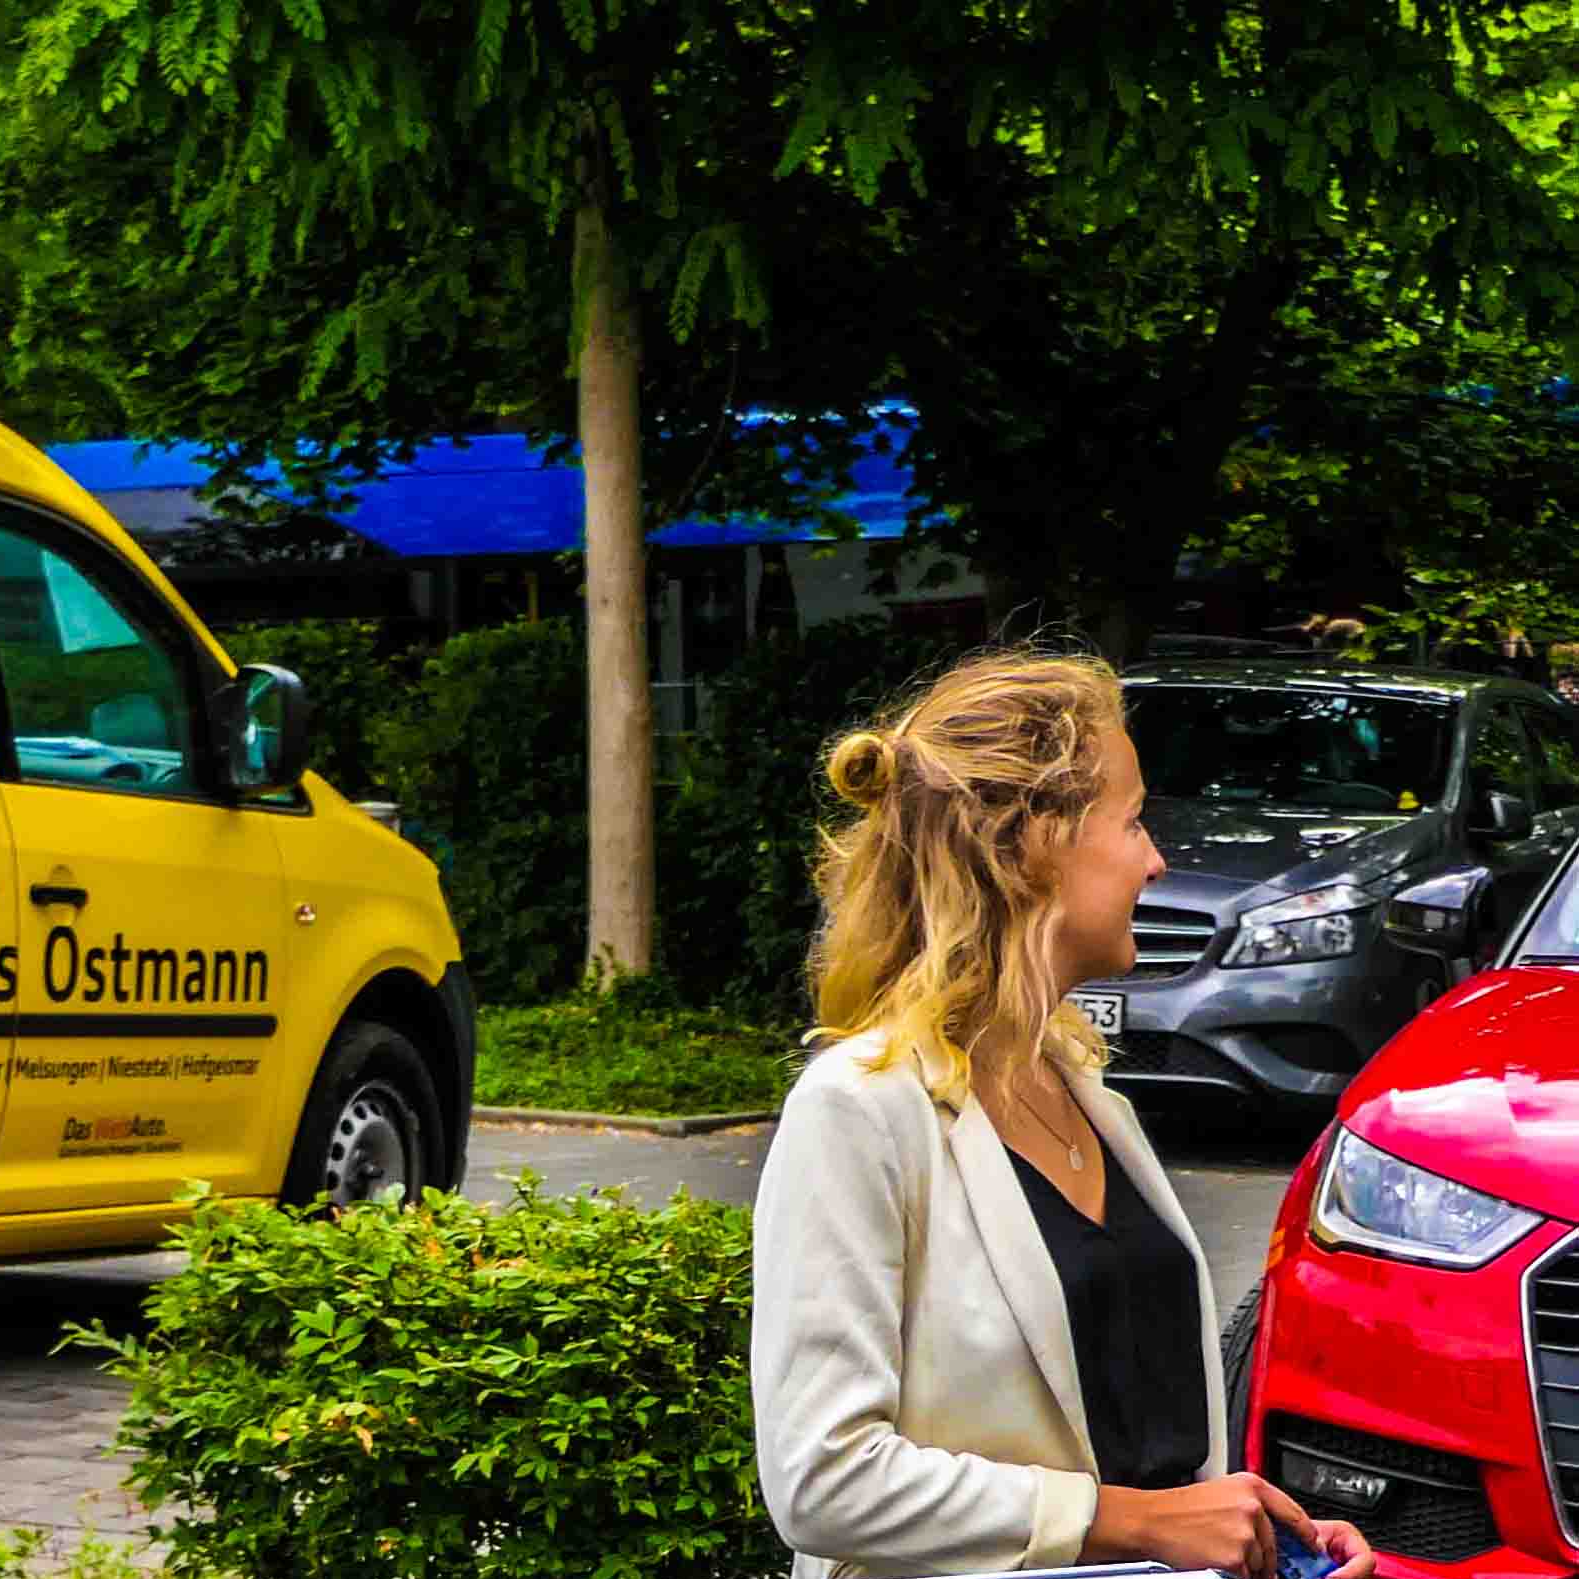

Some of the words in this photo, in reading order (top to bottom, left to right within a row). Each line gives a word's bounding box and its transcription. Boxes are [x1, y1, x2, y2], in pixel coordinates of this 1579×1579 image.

[45, 925, 270, 1003] Ostmann
[15, 1056, 98, 1086] Melsungen
[108, 1056, 171, 1079] Niestetal
[182, 1054, 259, 1083] Hofgeismar
